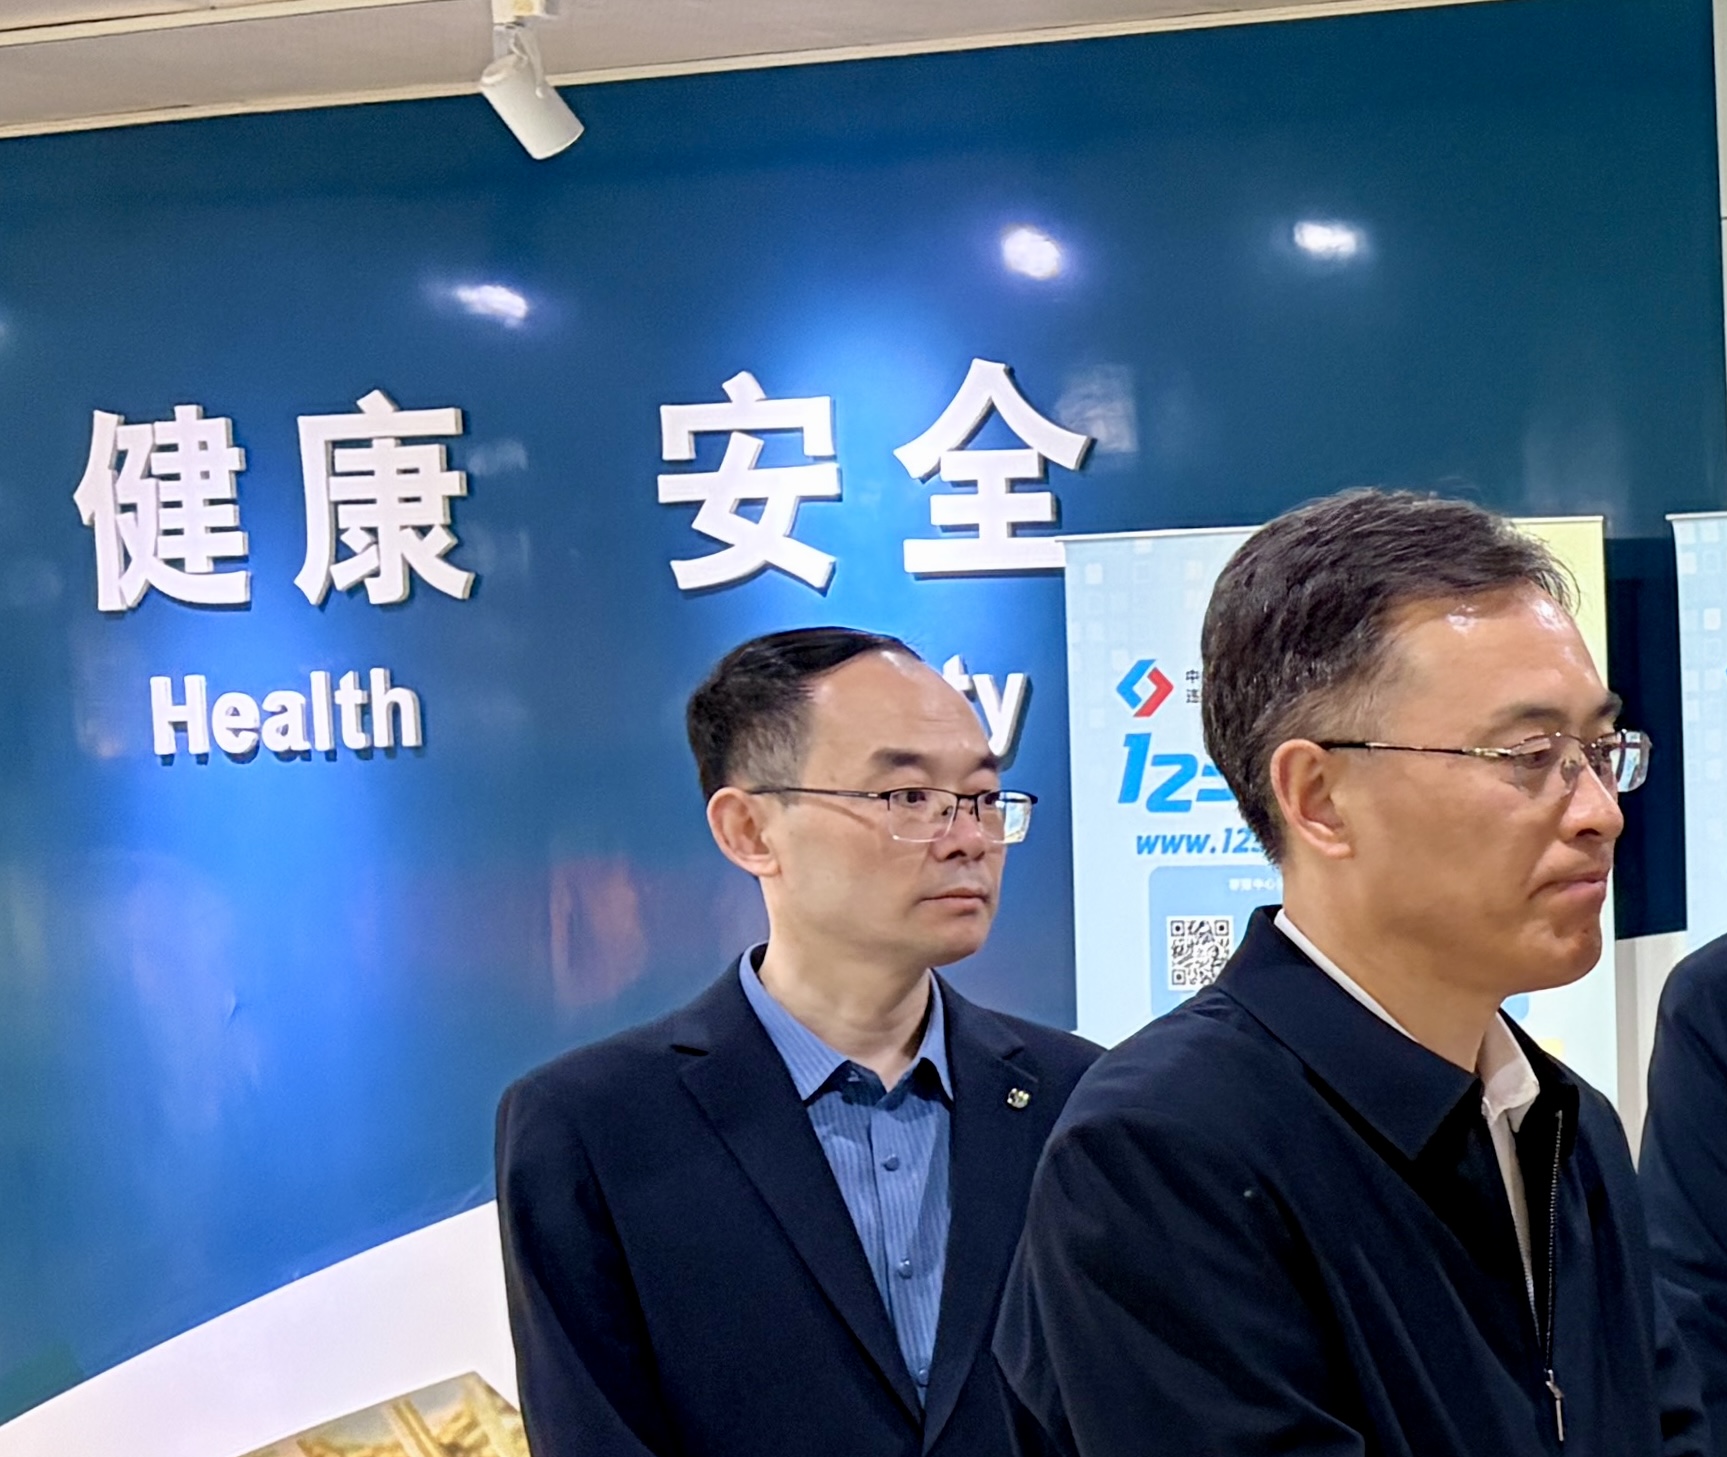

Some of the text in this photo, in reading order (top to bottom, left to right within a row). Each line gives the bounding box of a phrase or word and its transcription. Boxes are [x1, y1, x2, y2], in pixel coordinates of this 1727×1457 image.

[74, 358, 1094, 613] 健康 安全
[149, 666, 422, 757] Health
[1136, 827, 1266, 856] www.12
